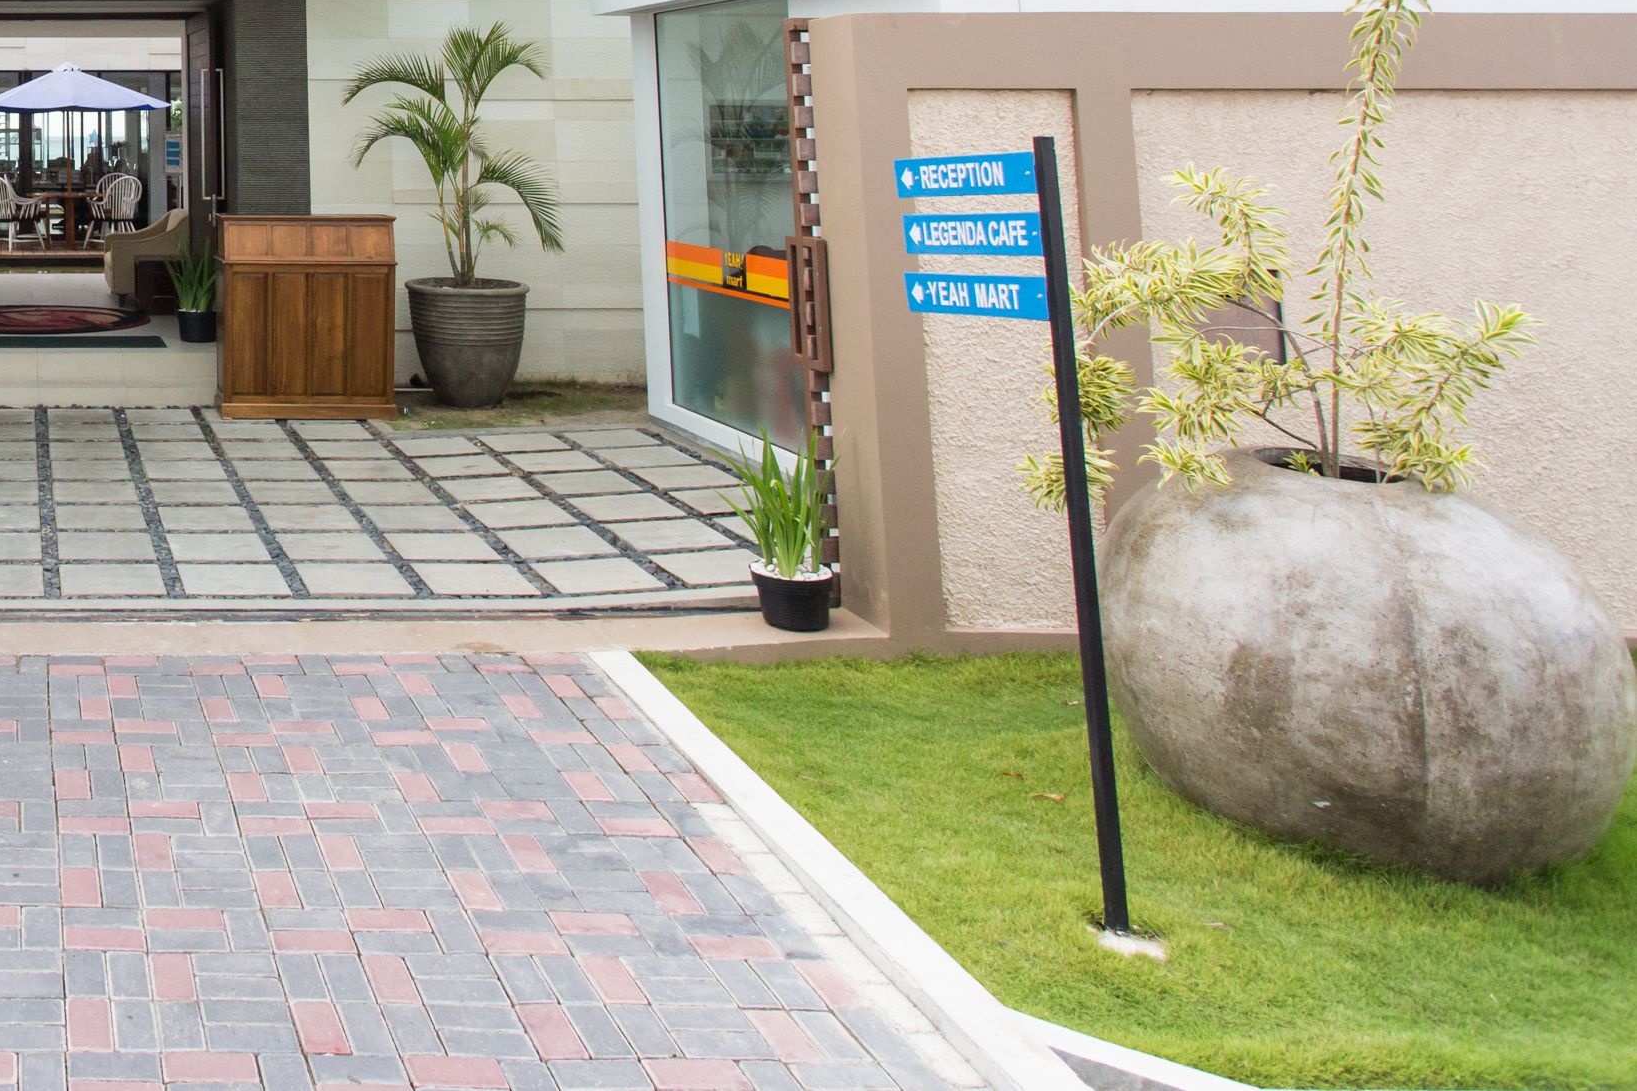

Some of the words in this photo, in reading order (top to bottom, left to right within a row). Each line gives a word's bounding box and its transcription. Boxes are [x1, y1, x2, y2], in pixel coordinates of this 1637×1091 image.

[919, 161, 1005, 189] RECEPTION
[922, 221, 988, 246] LEGENDA
[987, 220, 1029, 246] CAFE
[927, 281, 970, 307] YEAH
[974, 283, 1020, 310] MART
